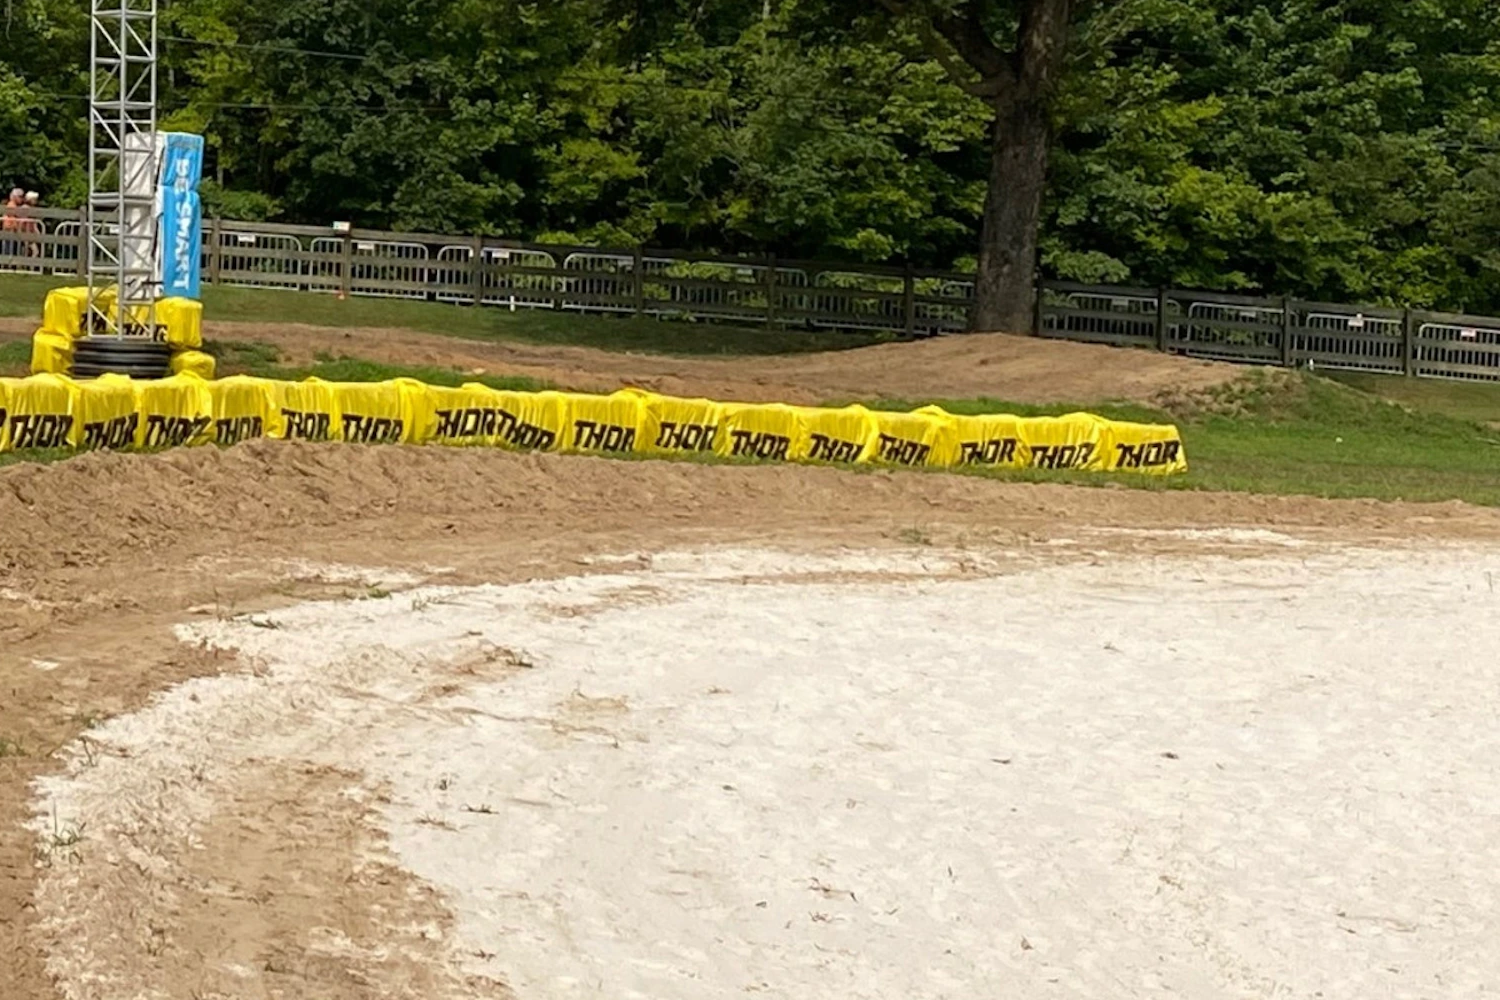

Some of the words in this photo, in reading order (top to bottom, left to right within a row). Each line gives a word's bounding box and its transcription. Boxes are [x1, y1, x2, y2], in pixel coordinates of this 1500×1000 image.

[172, 202, 194, 291] SMART
[10, 415, 73, 448] THOR
[84, 412, 139, 451] THOR
[281, 407, 330, 442] THOR
[341, 414, 404, 444] THOR
[435, 408, 496, 437] THOR
[494, 408, 556, 450] THOR
[574, 420, 635, 452] THOR
[656, 422, 718, 451] THOR
[731, 430, 790, 460] THOR
[879, 433, 930, 466] THOR
[961, 438, 1017, 466] THOR
[1030, 443, 1095, 469] THOR
[1116, 440, 1180, 468] THOR
